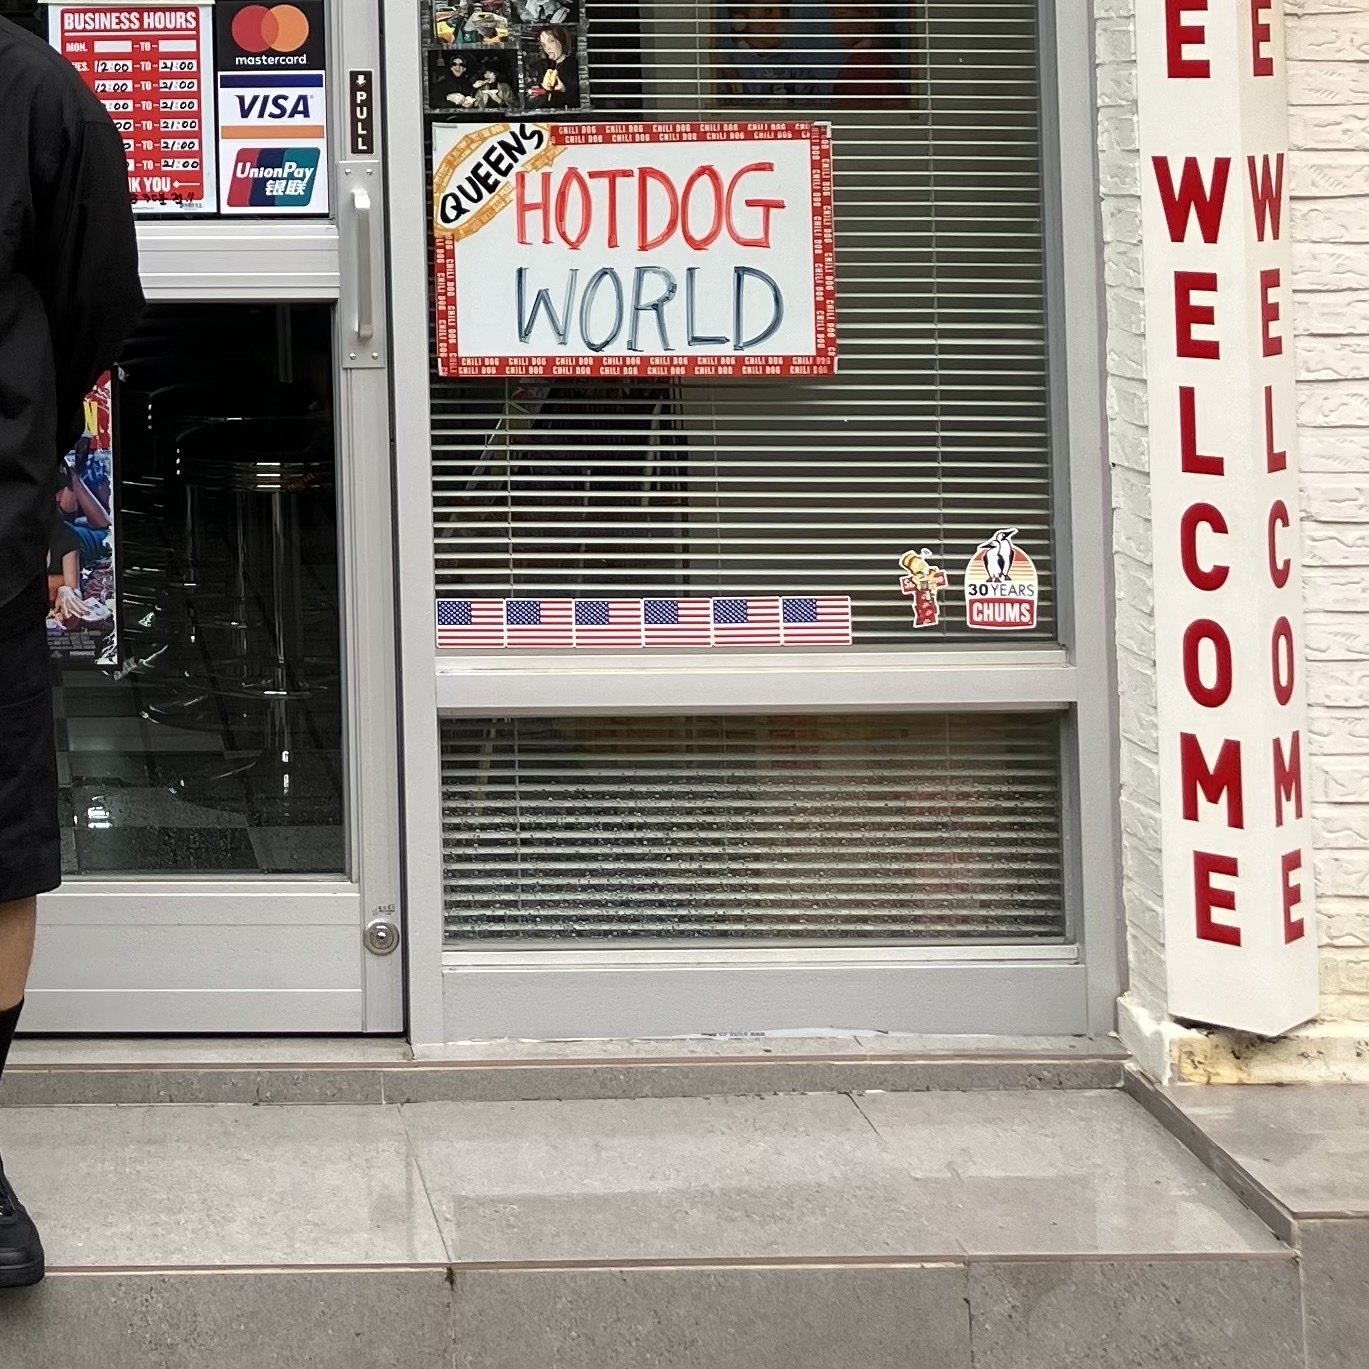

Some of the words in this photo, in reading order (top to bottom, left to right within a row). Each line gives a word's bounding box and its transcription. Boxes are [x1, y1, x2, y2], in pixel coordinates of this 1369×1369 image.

[64, 13, 140, 30] BUSINESS
[144, 11, 197, 29] HOURS
[66, 42, 88, 52] MON.
[96, 59, 129, 73] 12:00
[161, 61, 194, 70] 21:00
[236, 54, 307, 65] mastercard
[160, 79, 195, 90] 21:00
[161, 101, 195, 110] 21:00
[234, 94, 311, 119] VISA
[162, 120, 197, 129] 21:00
[356, 91, 368, 150] PULL
[162, 141, 196, 149] 21:00
[162, 160, 200, 169] 21:00
[236, 162, 315, 183] UnionPay
[440, 123, 544, 224] QUEENS
[143, 177, 171, 192] YOU
[265, 181, 307, 196] 银联
[515, 162, 786, 251] HOTDOG
[516, 266, 784, 352] WORLD
[1151, 156, 1245, 948] WELCOME
[1246, 153, 1305, 946] WELCOME
[968, 583, 988, 596] 30
[991, 583, 1034, 597] YEARS
[972, 602, 1031, 623] CHUMS
